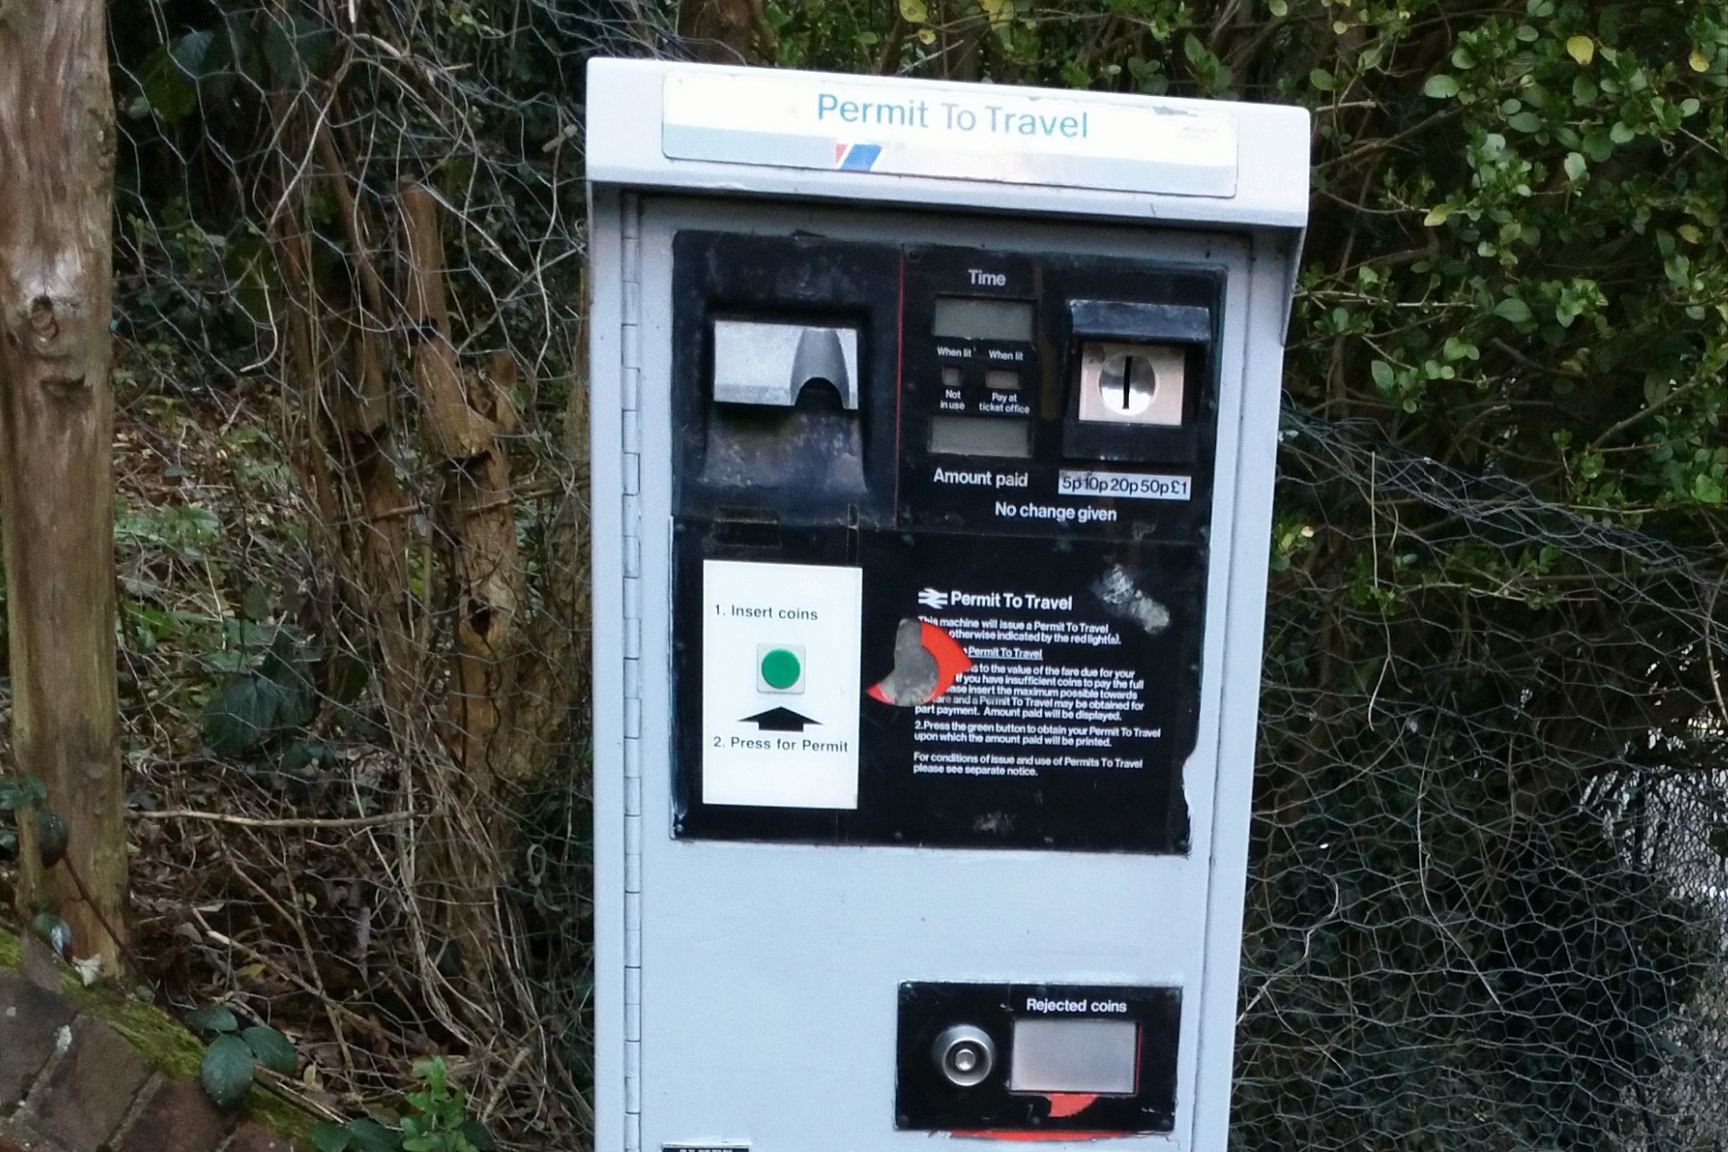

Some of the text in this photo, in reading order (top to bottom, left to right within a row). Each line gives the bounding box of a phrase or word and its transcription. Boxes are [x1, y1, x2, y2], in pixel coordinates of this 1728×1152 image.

[818, 93, 1088, 138] Permit To Travel
[968, 269, 1006, 286] Time
[937, 346, 972, 358] When lit
[988, 349, 1024, 361] When lit
[945, 389, 961, 399] Not
[992, 392, 1017, 403] Pay at
[940, 400, 965, 410] in use
[979, 402, 1030, 414] ticket office
[933, 467, 1028, 488] Amount paid
[1110, 478, 1138, 495] 20p
[1140, 480, 1169, 496] 50p
[1171, 480, 1187, 495] £1
[995, 501, 1117, 523] No change given
[951, 591, 1072, 611] Permit To Travel
[714, 604, 818, 620] 1. Insert coins
[940, 618, 979, 628] machine
[982, 619, 998, 629] will
[1000, 620, 1025, 630] issue
[1034, 621, 1065, 632] Permit
[1066, 622, 1078, 632] To
[1079, 623, 1109, 633] Travel
[949, 629, 996, 639] otherwise
[997, 631, 1040, 642] indicated
[1041, 633, 1052, 644] by
[1054, 633, 1069, 643] the
[1071, 634, 1087, 643] red
[968, 646, 999, 657] Permit
[1000, 647, 1012, 658] To
[1013, 648, 1042, 659] Travel
[980, 664, 990, 673] to
[991, 664, 1006, 674] the
[1007, 665, 1031, 675] value
[1033, 665, 1044, 675] of
[1045, 666, 1060, 675] the
[1061, 666, 1079, 676] fare
[1080, 667, 1098, 677] due
[1099, 668, 1113, 677] for
[1114, 670, 1135, 679] your
[964, 675, 980, 684] you
[982, 674, 1004, 684] have
[1005, 675, 1056, 686] insufficient
[1057, 677, 1082, 687] coins
[1083, 678, 1093, 688] to
[1094, 680, 1111, 690] pay
[1113, 679, 1128, 689] the
[1129, 679, 1144, 690] full
[968, 685, 995, 694] insert
[997, 685, 1012, 695] the
[1014, 686, 1059, 697] maximum
[1060, 688, 1099, 699] possible
[1100, 689, 1138, 700] towards
[953, 695, 971, 705] and
[972, 697, 978, 705] a
[980, 695, 1010, 706] Permit
[1011, 697, 1023, 706] To
[1025, 697, 1053, 708] Travel
[1054, 700, 1074, 710] may
[1075, 699, 1088, 709] be
[1089, 700, 1129, 711] obtained
[1131, 701, 1144, 711] for
[915, 704, 1122, 722] part payment. Amount paid will be displayed.
[952, 721, 966, 731] the
[967, 722, 994, 733] green
[996, 723, 1026, 733] button
[1027, 724, 1036, 733] to
[1037, 724, 1067, 734] obtain
[1068, 727, 1088, 736] your
[1089, 726, 1119, 736] Permit
[1121, 727, 1132, 737] To
[1133, 728, 1161, 738] Travel
[713, 736, 848, 753] 2. Press for Permit
[914, 732, 1112, 747] upon which the amount paid will be printed.
[913, 751, 1143, 769] For conditions of issue and use of Permits To Travel
[913, 763, 1038, 776] please see separate notice.
[1026, 998, 1127, 1014] Rejected coins
